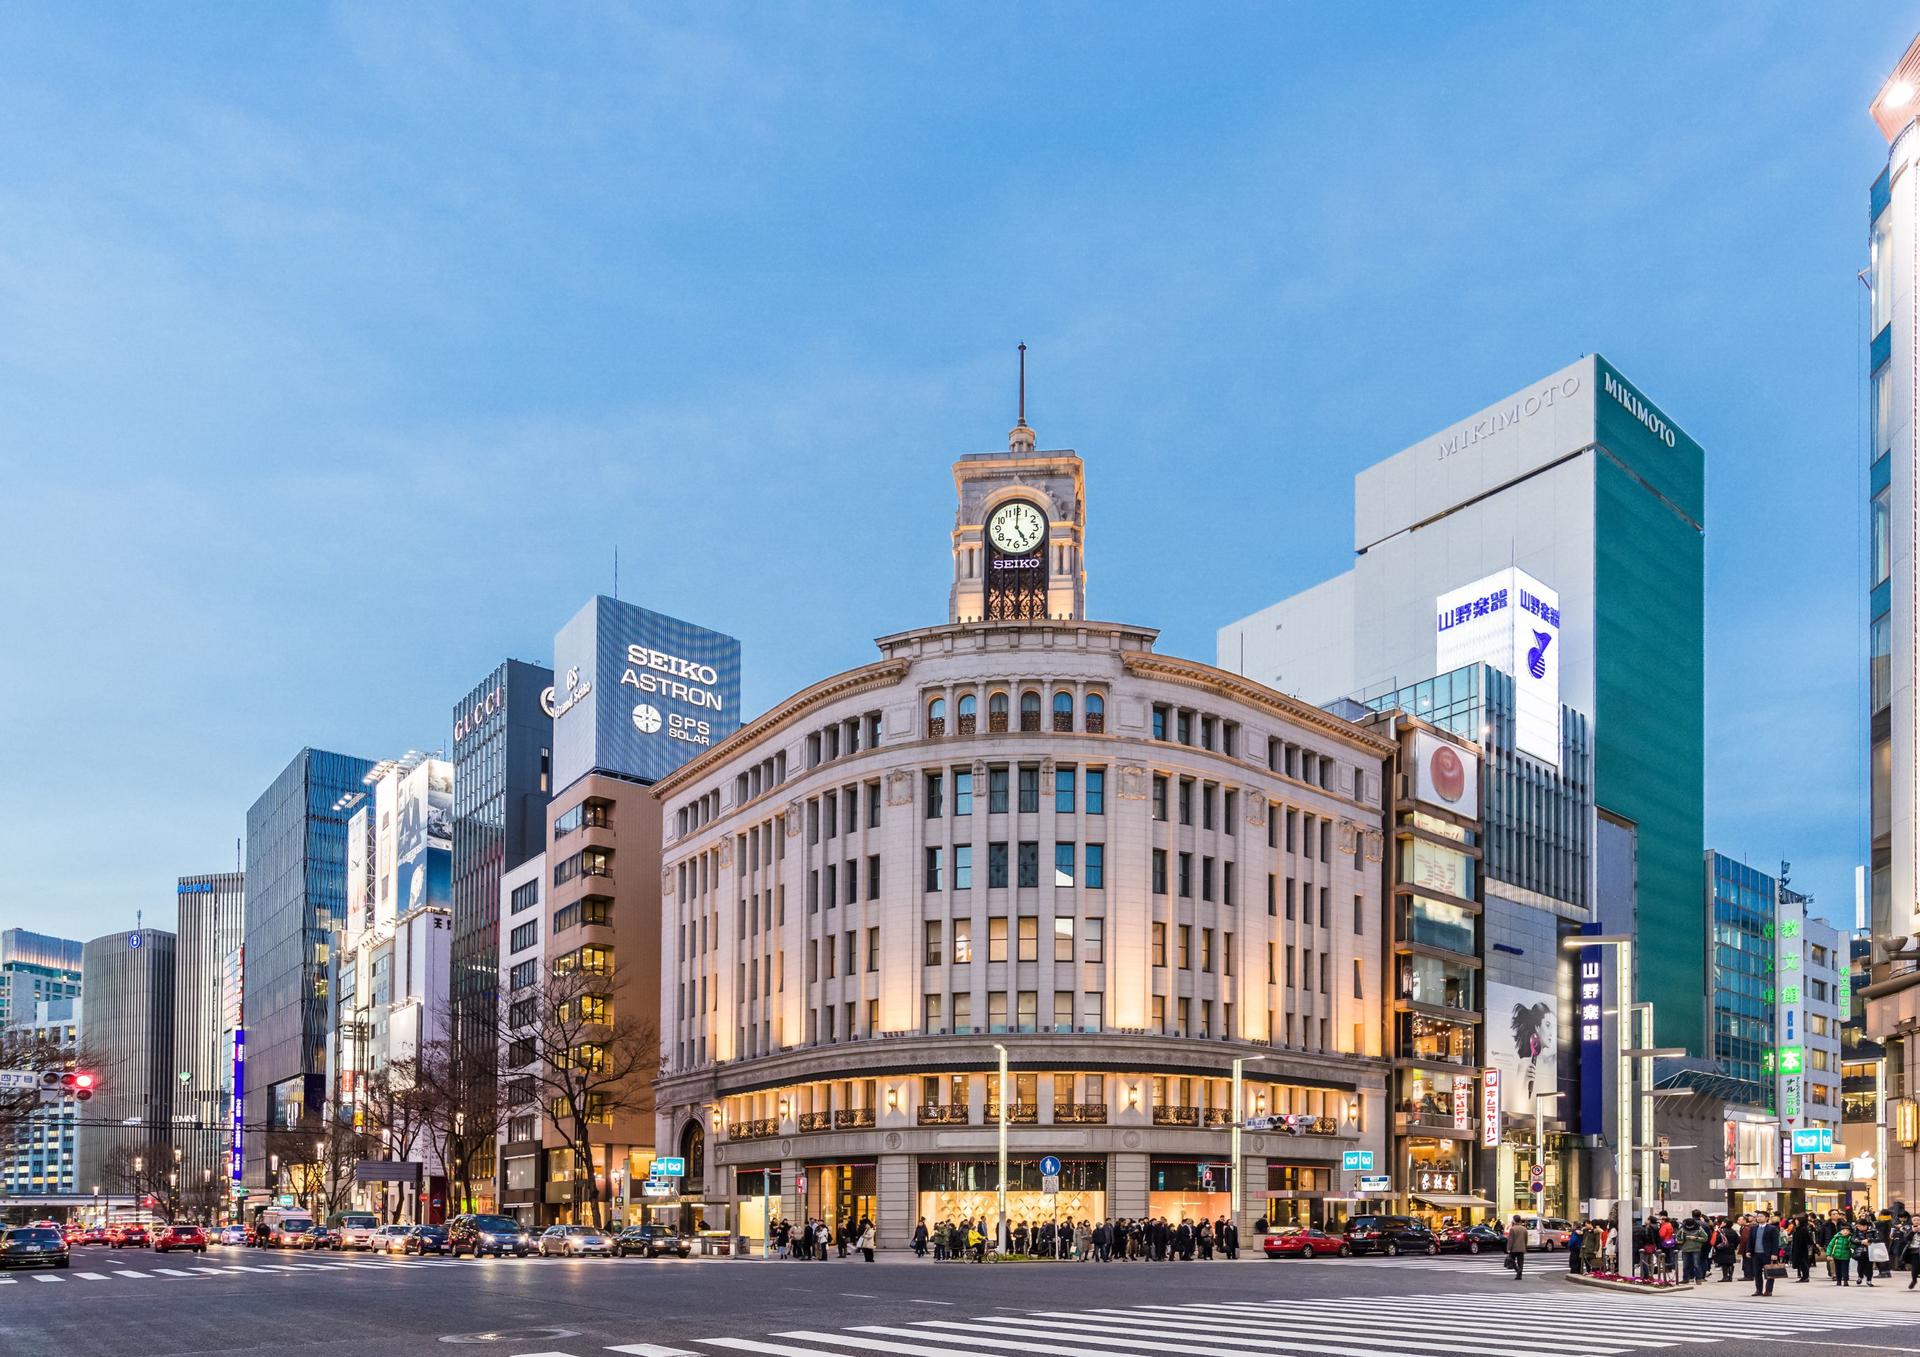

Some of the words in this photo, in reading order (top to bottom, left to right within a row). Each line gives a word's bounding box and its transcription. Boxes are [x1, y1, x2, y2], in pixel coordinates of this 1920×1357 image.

[1604, 370, 1676, 449] MIKIMOTO
[1437, 376, 1582, 462] MIKIMOTO
[998, 516, 1006, 524] 10
[1006, 510, 1012, 518] 11
[1030, 515, 1036, 524] 2
[995, 524, 1002, 533] 9
[998, 532, 1004, 542] 8
[1029, 532, 1036, 540] 4
[1034, 524, 1040, 532] 3
[1006, 538, 1012, 546] 7
[1014, 540, 1020, 548] 6
[1023, 538, 1028, 546] 5
[993, 559, 1040, 570] SEIKO
[1438, 588, 1508, 632] 山野楽器
[1520, 588, 1560, 630] 山野楽器
[626, 643, 718, 686] SEIKO
[620, 668, 722, 712] ASTRON
[554, 690, 574, 719] Grand
[574, 680, 592, 703] Seiko
[454, 686, 502, 742] GUCCI
[668, 713, 710, 736] GPS
[668, 728, 710, 747] SOLAR
[1780, 919, 1800, 1004] 教文館
[1582, 962, 1599, 1040] 山野楽器
[1782, 1052, 1800, 1070] 本
[1, 1074, 33, 1083] 四丁目
